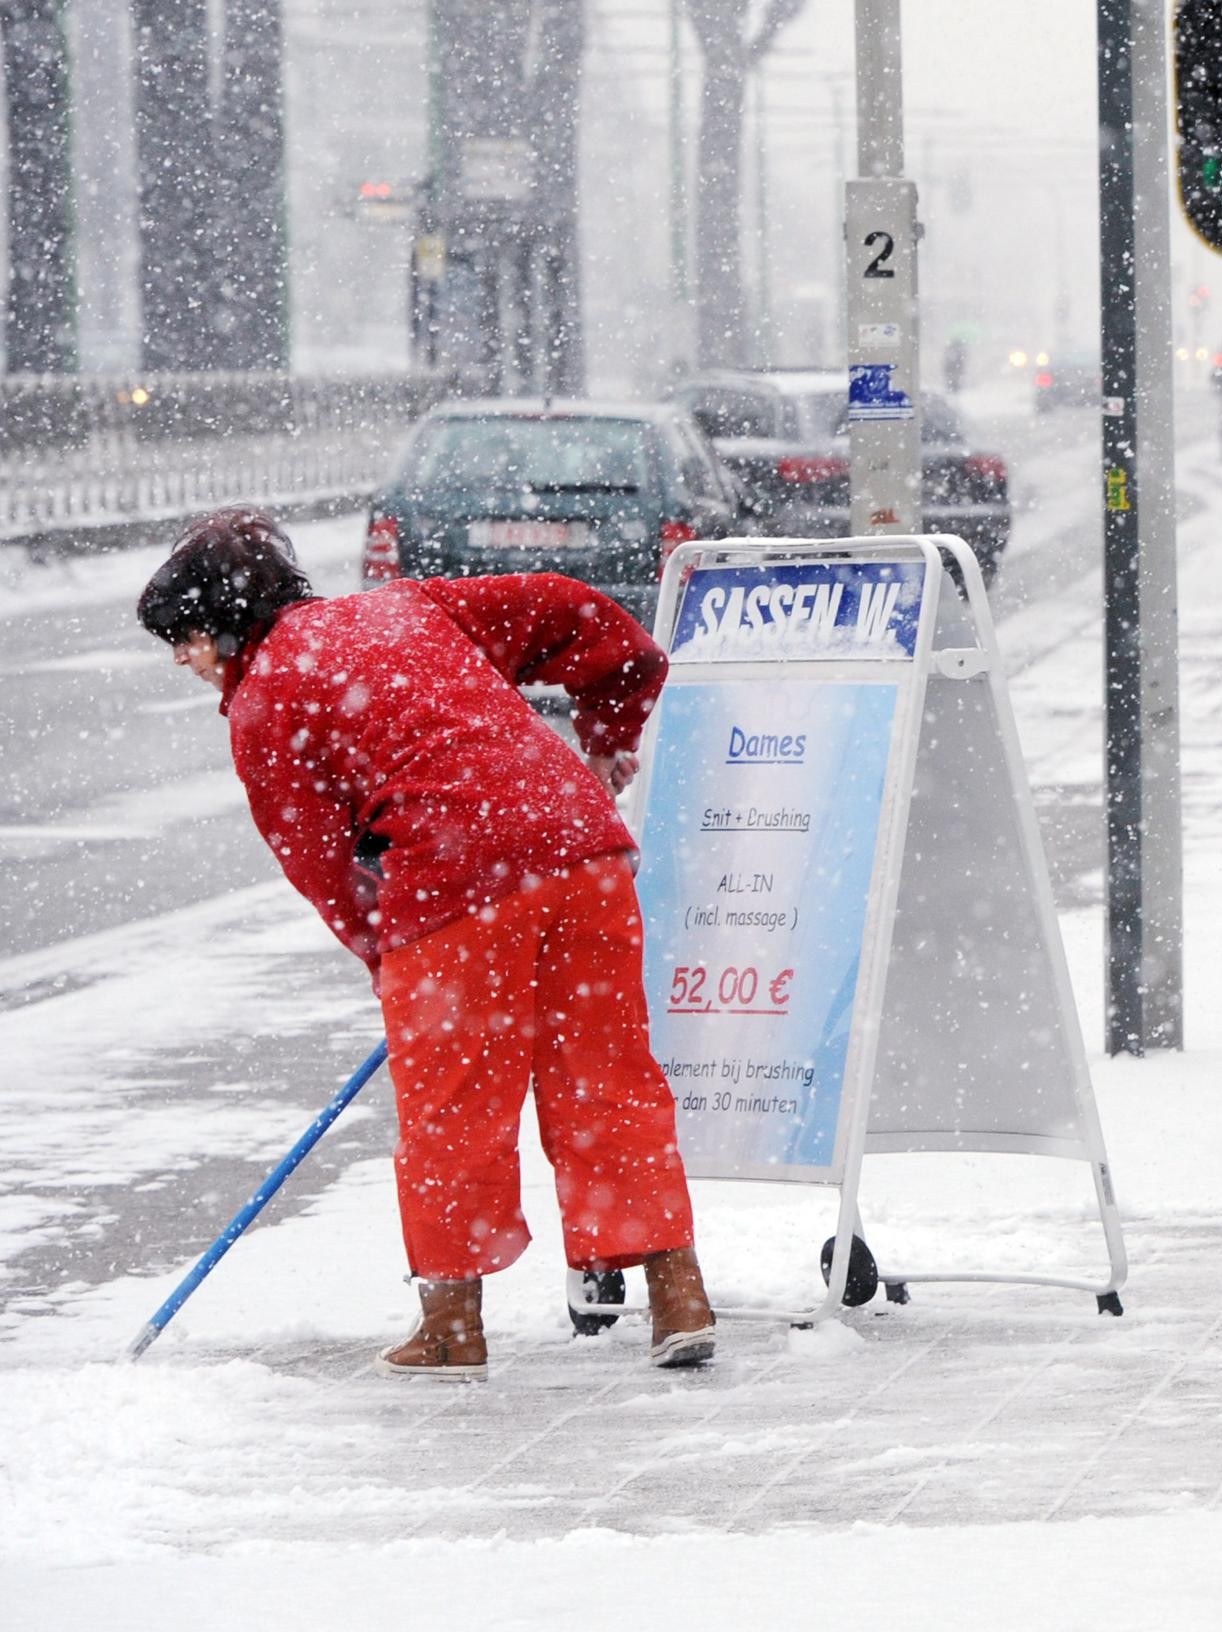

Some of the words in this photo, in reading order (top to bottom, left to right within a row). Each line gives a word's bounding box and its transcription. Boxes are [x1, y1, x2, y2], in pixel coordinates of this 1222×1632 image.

[864, 231, 895, 278] 2
[694, 583, 845, 638] SASSEN
[728, 726, 808, 758] Dames
[702, 808, 732, 827] Snit
[717, 873, 774, 893] ALL-IN
[694, 906, 721, 926] incl.
[725, 911, 787, 932] massage
[670, 966, 758, 1010] 52,00
[768, 968, 794, 1005] €
[658, 1057, 717, 1077] plement
[721, 1058, 742, 1084] bij
[746, 1058, 815, 1087] brushing
[682, 1090, 707, 1111] dan
[711, 1091, 732, 1111] 30
[735, 1094, 797, 1114] minuten
